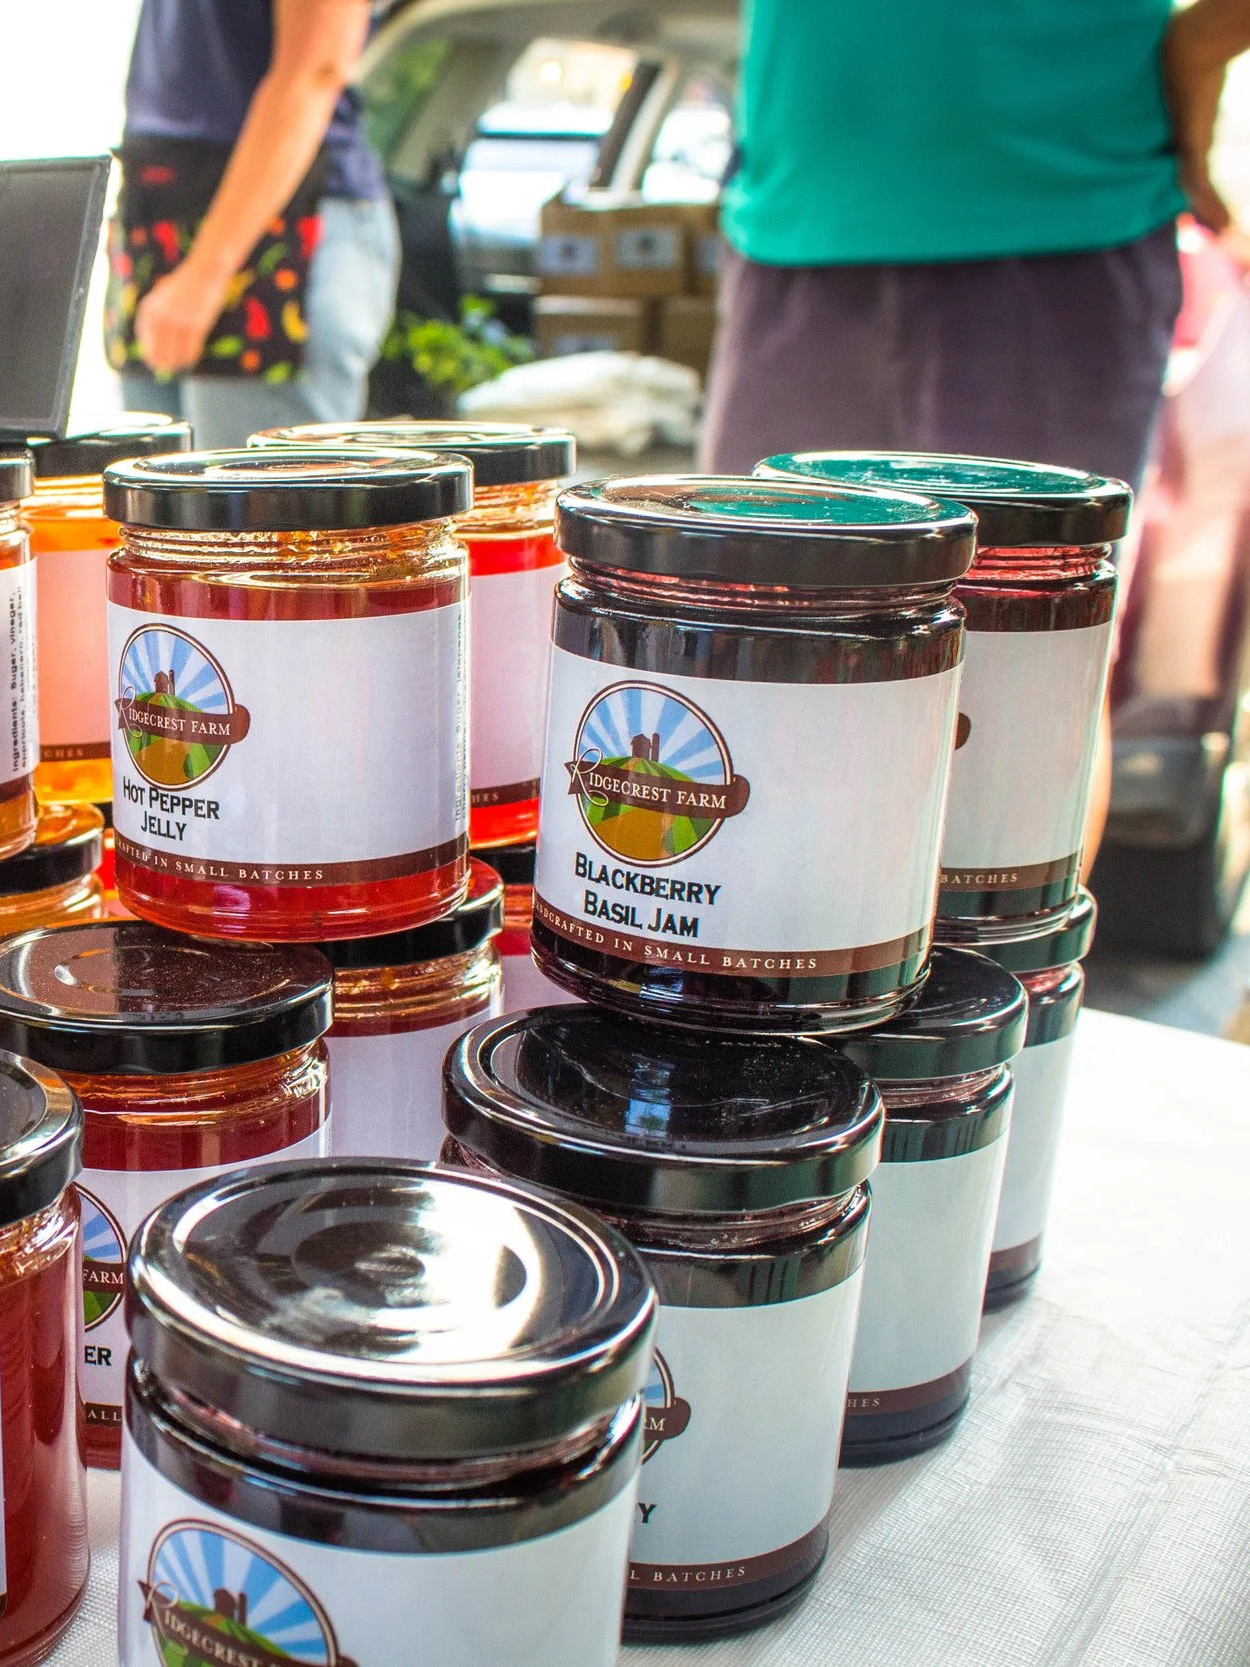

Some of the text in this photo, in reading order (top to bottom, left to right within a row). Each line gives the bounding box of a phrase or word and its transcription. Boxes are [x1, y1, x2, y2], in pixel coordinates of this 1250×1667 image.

[191, 720, 231, 736] FARM
[570, 748, 726, 809] RIDGECREST FARM
[123, 776, 220, 820] HOT PEPPER
[140, 811, 187, 841] JELLY
[154, 856, 168, 867] IN
[176, 861, 228, 876] SMALL
[239, 869, 323, 880] BATCHES
[574, 851, 722, 906] BLACKBERRY
[940, 873, 1018, 884] BATCHES
[583, 889, 699, 938] BASIL JAM
[614, 938, 633, 951] IN
[644, 945, 710, 965] SMALL
[722, 957, 817, 969] BATCHES
[87, 1410, 122, 1421] ALL
[653, 1566, 746, 1582] BATCHES
